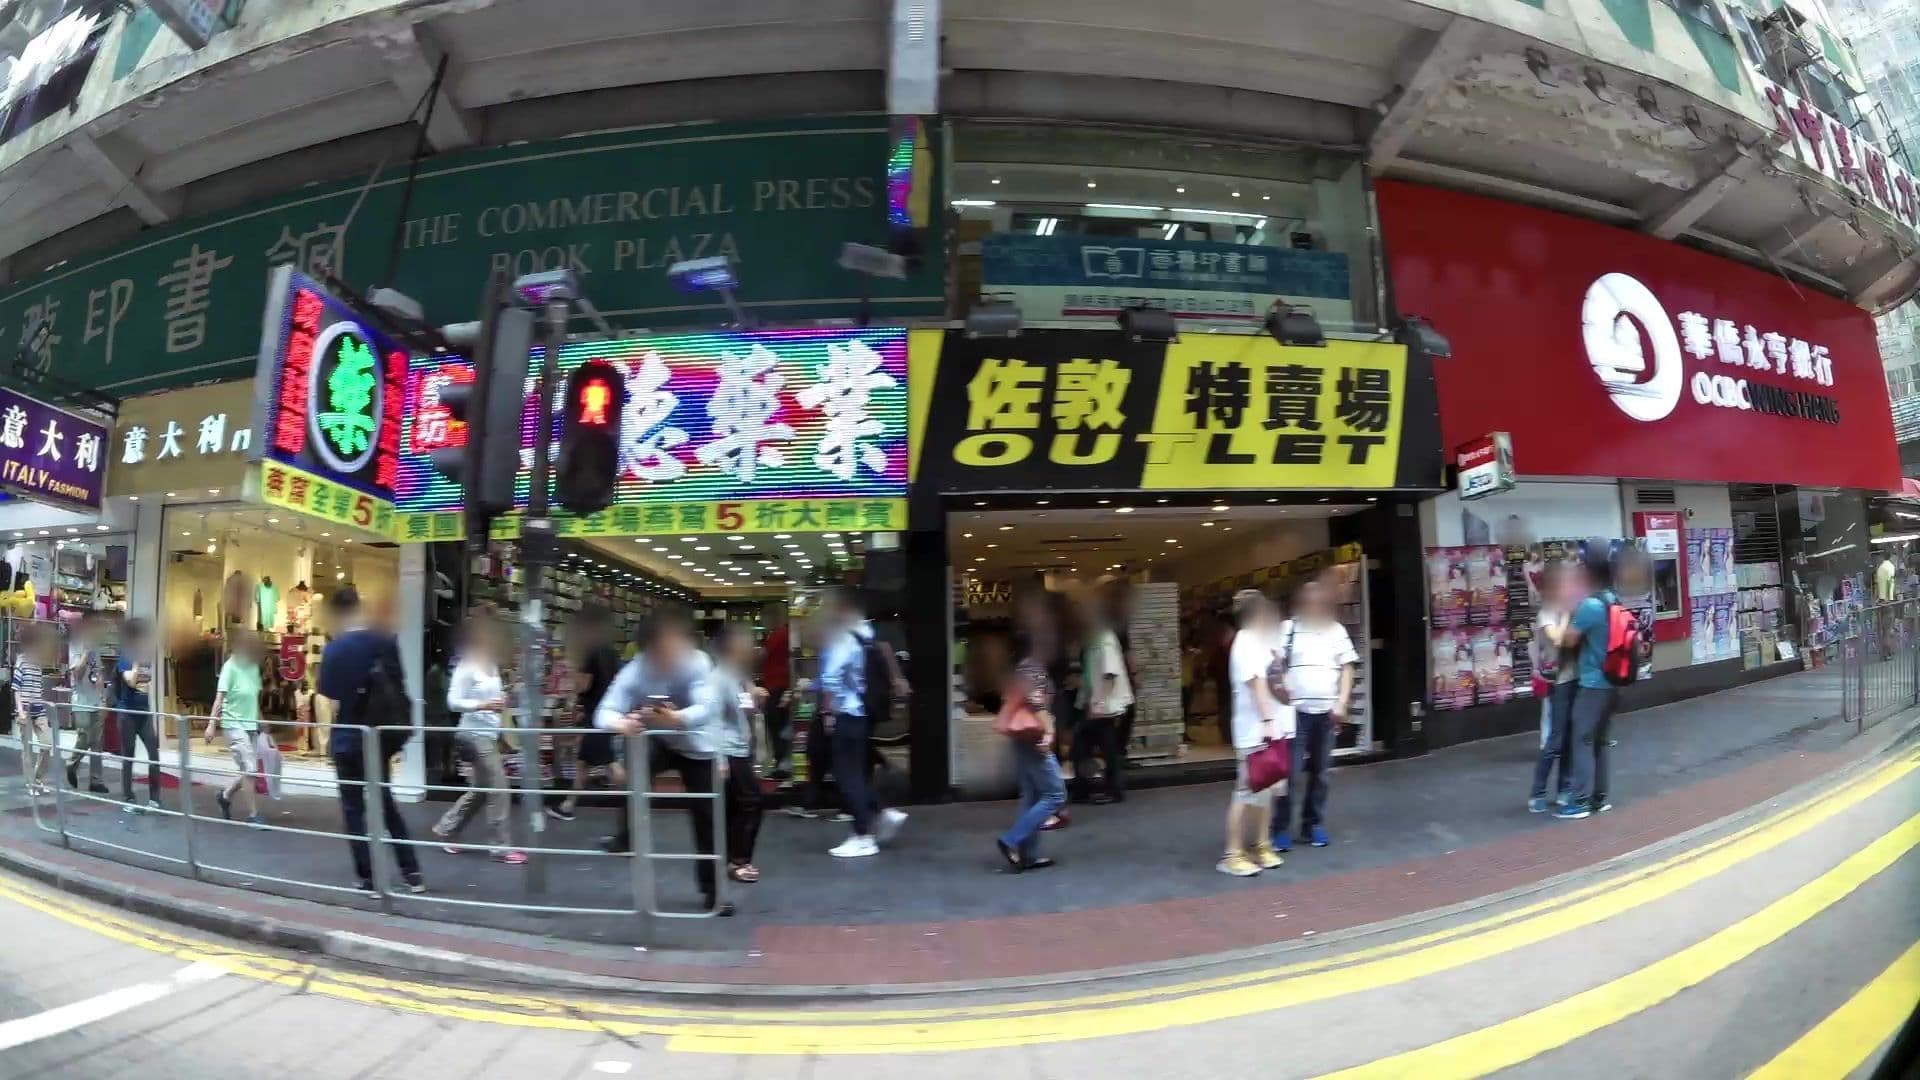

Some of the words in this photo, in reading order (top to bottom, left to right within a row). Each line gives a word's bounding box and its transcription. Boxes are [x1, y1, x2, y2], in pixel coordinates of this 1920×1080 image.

[401, 213, 462, 249] THE
[477, 183, 733, 238] COMMERCIAL
[752, 177, 874, 212] PRESS
[613, 232, 742, 271] PLAZA
[966, 357, 1133, 431] 佐敦
[1185, 360, 1392, 434] 特賣場
[1691, 371, 1752, 410] OCBC
[0, 404, 101, 473] 意大利
[121, 413, 229, 464] 意大利
[952, 432, 1387, 466] OUTLET
[3, 459, 50, 490] ITALY
[48, 478, 89, 500] FASHION
